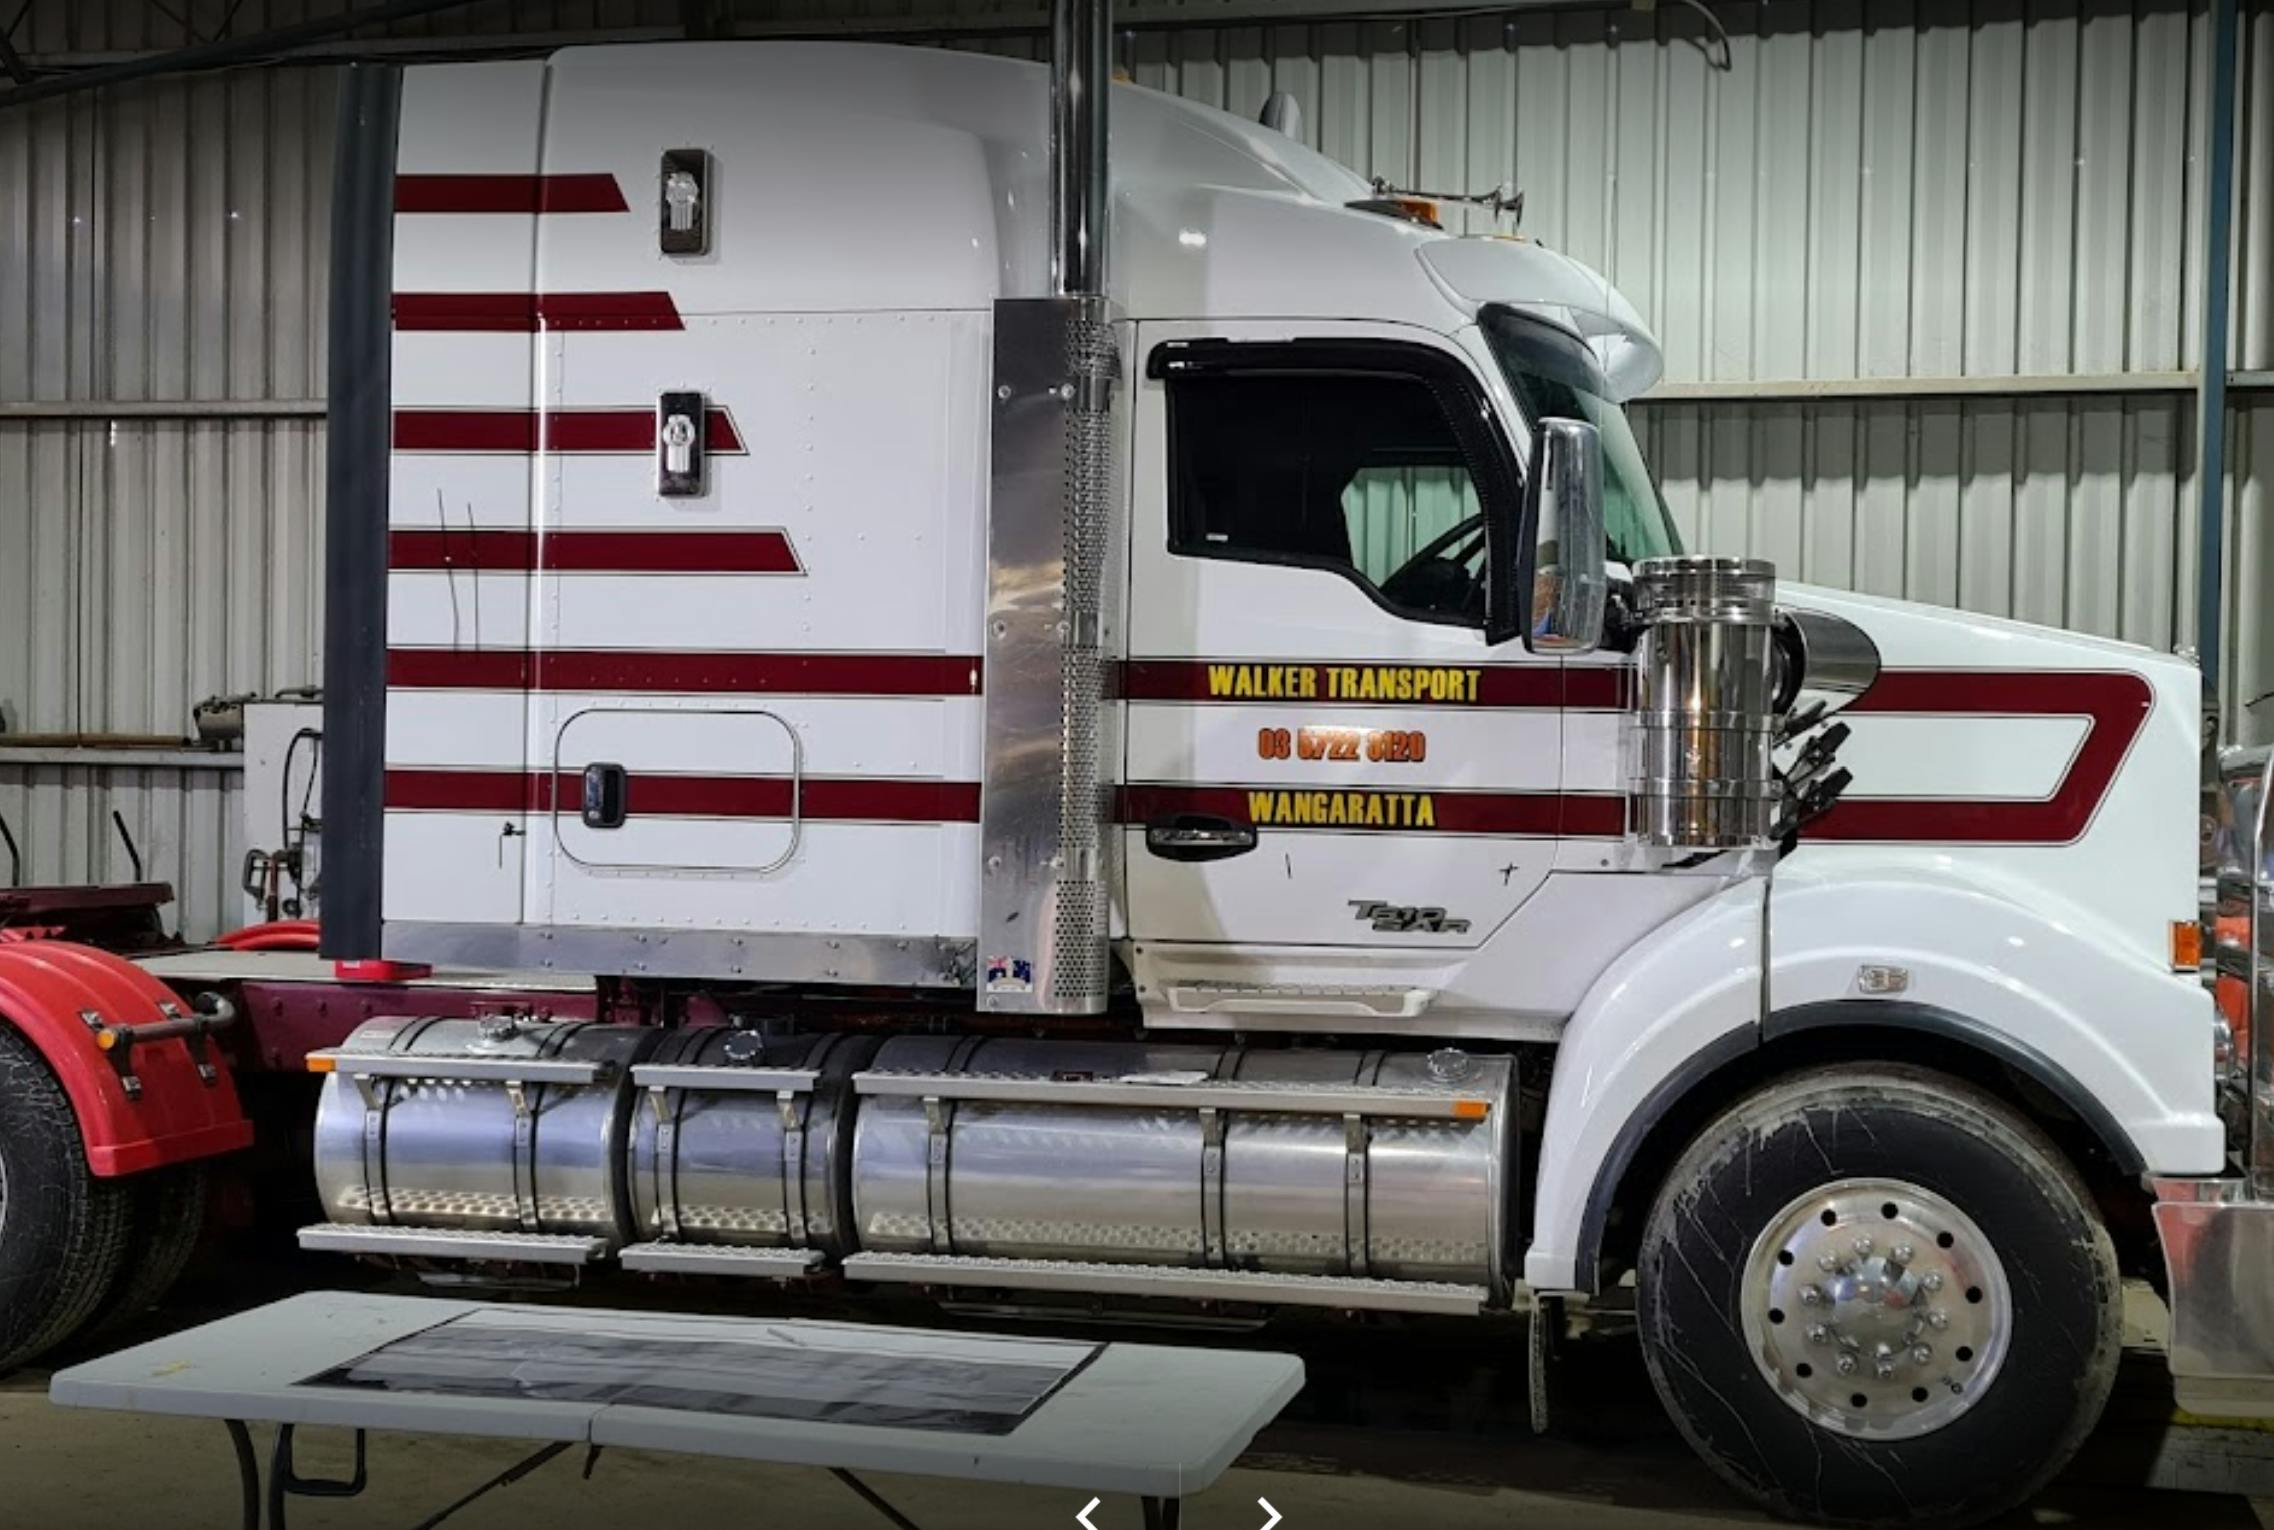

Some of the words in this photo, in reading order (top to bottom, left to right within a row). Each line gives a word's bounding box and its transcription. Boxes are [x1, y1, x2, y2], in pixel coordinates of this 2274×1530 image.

[1208, 665, 1317, 697] WALKER
[1326, 667, 1481, 702] TRANSPORT
[1258, 728, 1291, 760] 03
[1248, 791, 1435, 826] WANGARATTA
